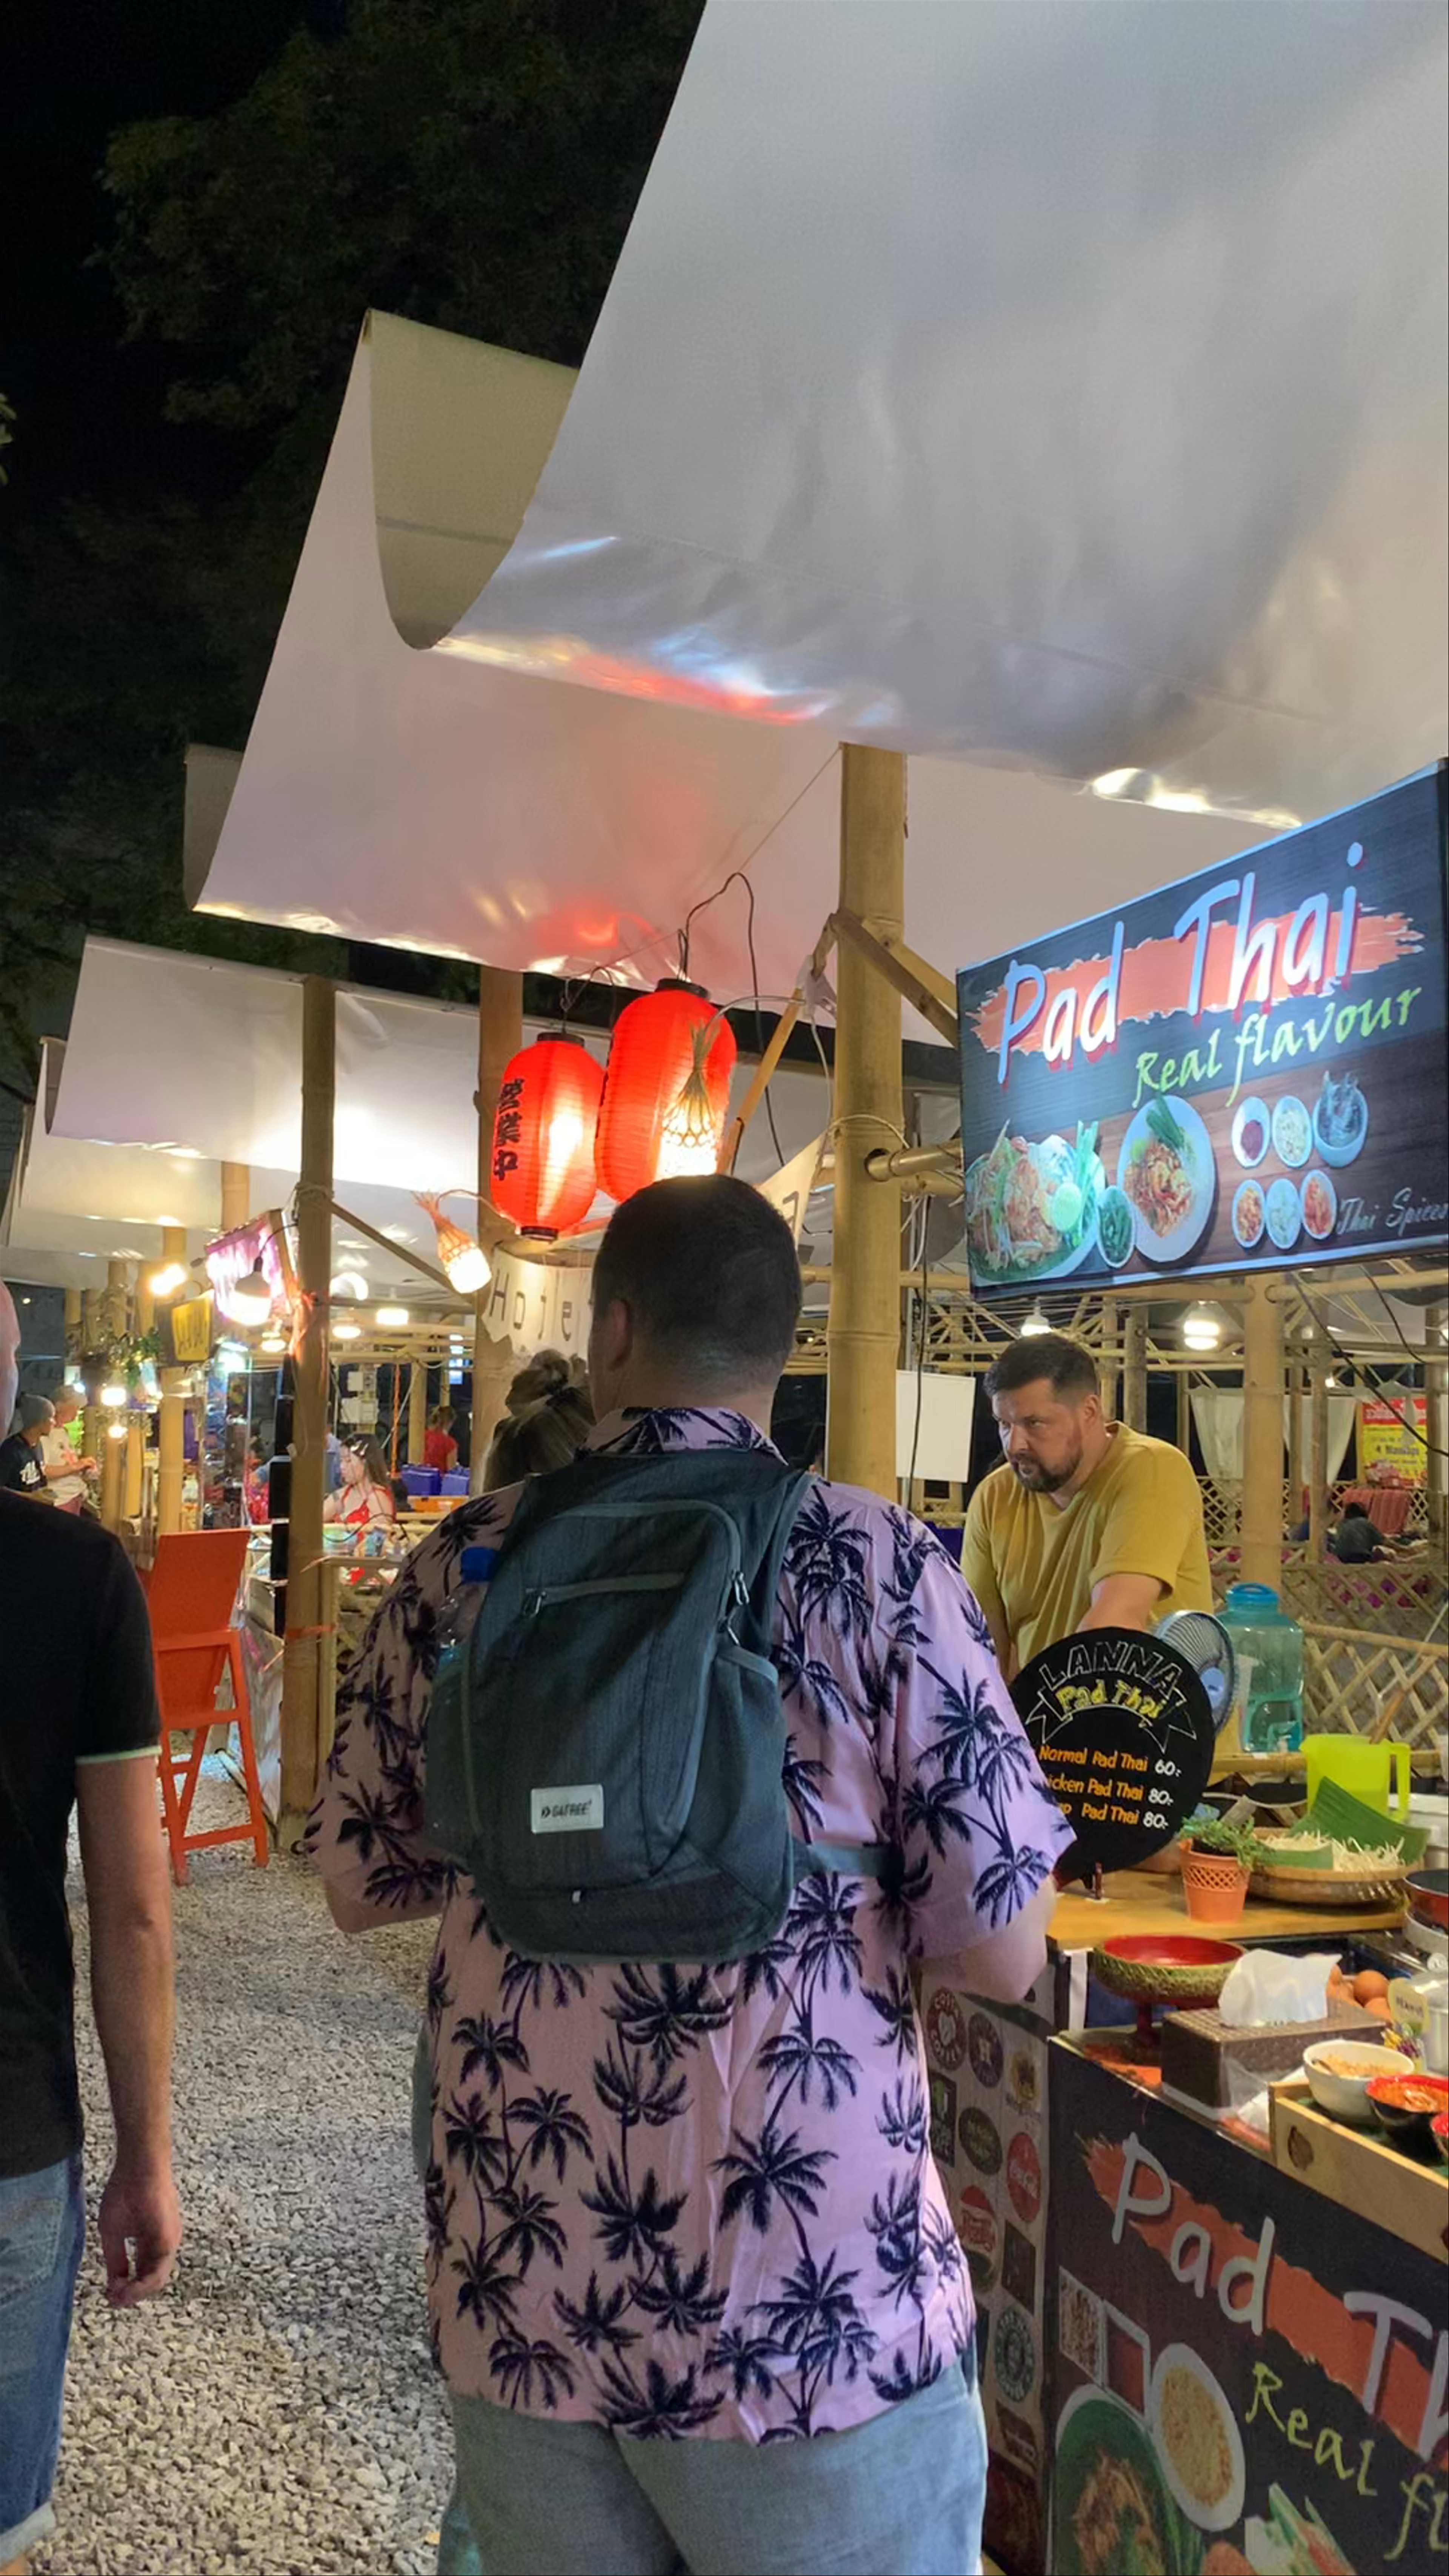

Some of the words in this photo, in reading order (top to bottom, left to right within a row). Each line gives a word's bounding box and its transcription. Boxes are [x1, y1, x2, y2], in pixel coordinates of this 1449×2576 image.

[997, 921, 1124, 1084] Pad
[1174, 842, 1363, 1017] Thai
[1133, 1041, 1222, 1108] Real
[1226, 986, 1422, 1107] flavour
[1336, 1196, 1380, 1235] Thai
[1039, 1641, 1183, 1699] LANNA
[1055, 1679, 1108, 1713] Pad
[1111, 1679, 1167, 1718] Thai
[1038, 1746, 1088, 1765] Normal
[1092, 1750, 1118, 1769] Pad
[1121, 1752, 1149, 1772] Thai
[1048, 1773, 1084, 1793] icken
[1088, 1778, 1112, 1797] Pad
[1117, 1781, 1145, 1801] Thai
[1081, 1802, 1108, 1820] Pad
[1110, 1806, 1139, 1825] Thai
[1112, 2132, 1275, 2336] Pad
[1245, 2361, 1378, 2496] Real
